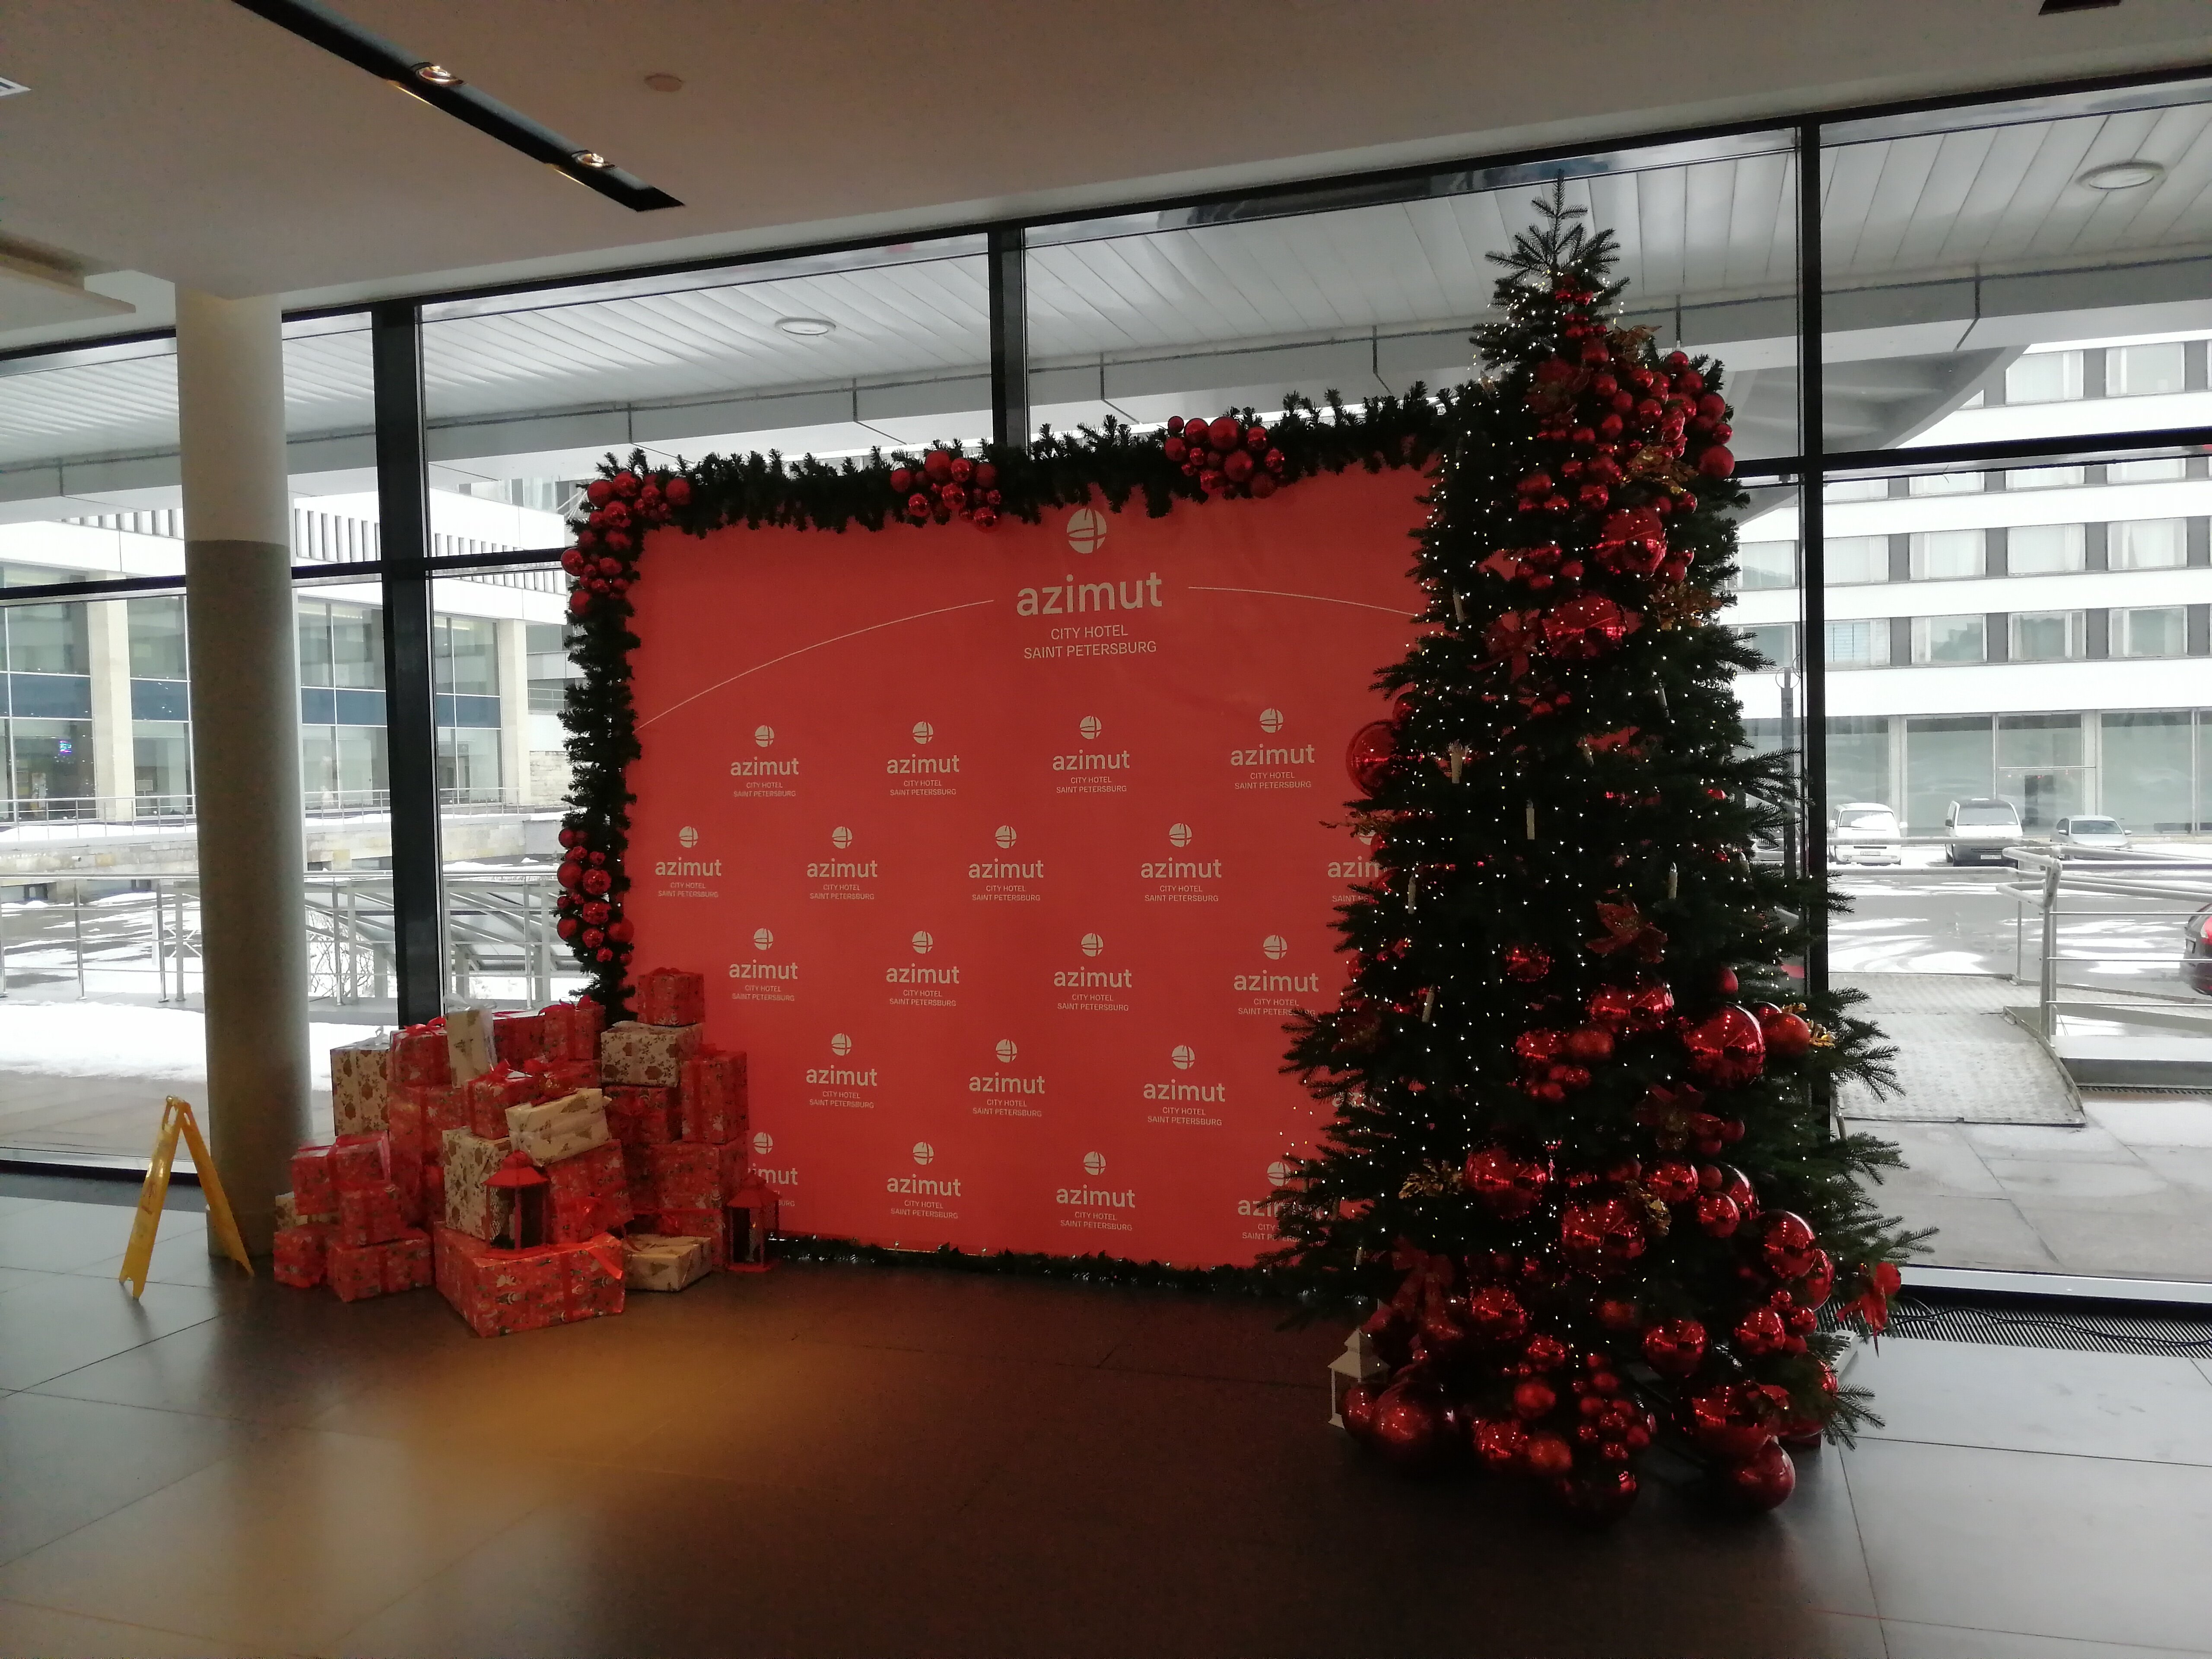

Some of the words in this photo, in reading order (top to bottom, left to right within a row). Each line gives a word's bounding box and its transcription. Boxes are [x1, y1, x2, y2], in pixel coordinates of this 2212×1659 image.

[1017, 572, 1162, 616] azimut
[1051, 627, 1081, 640] CITY
[1085, 624, 1128, 638] HOTEL
[1024, 646, 1063, 659] SAINT
[1067, 641, 1156, 657] PETERSBURG
[887, 754, 959, 774] azimut
[1053, 750, 1130, 771] azimut
[1230, 744, 1315, 766] azimut
[731, 756, 799, 775] azimut
[655, 857, 721, 876] azimut
[807, 858, 877, 878] azimut
[969, 858, 1043, 878] azimut
[1141, 857, 1221, 878] azimut
[729, 959, 798, 979] azimut
[886, 963, 960, 984] azimut
[1054, 966, 1132, 988] azimut
[1234, 970, 1319, 992] azimut
[806, 1065, 877, 1086] azimut
[969, 1072, 1045, 1094] azimut
[1144, 1079, 1225, 1102] azimut
[830, 1100, 874, 1108] PETERSBURG
[995, 1109, 1042, 1117] PETERSBURG
[1172, 1117, 1222, 1125] PETERSBURG
[887, 1174, 961, 1197] azimut
[1056, 1184, 1135, 1208] azimut
[912, 1209, 958, 1219] PETERSBURG
[1084, 1221, 1132, 1231] PETERSBURG
